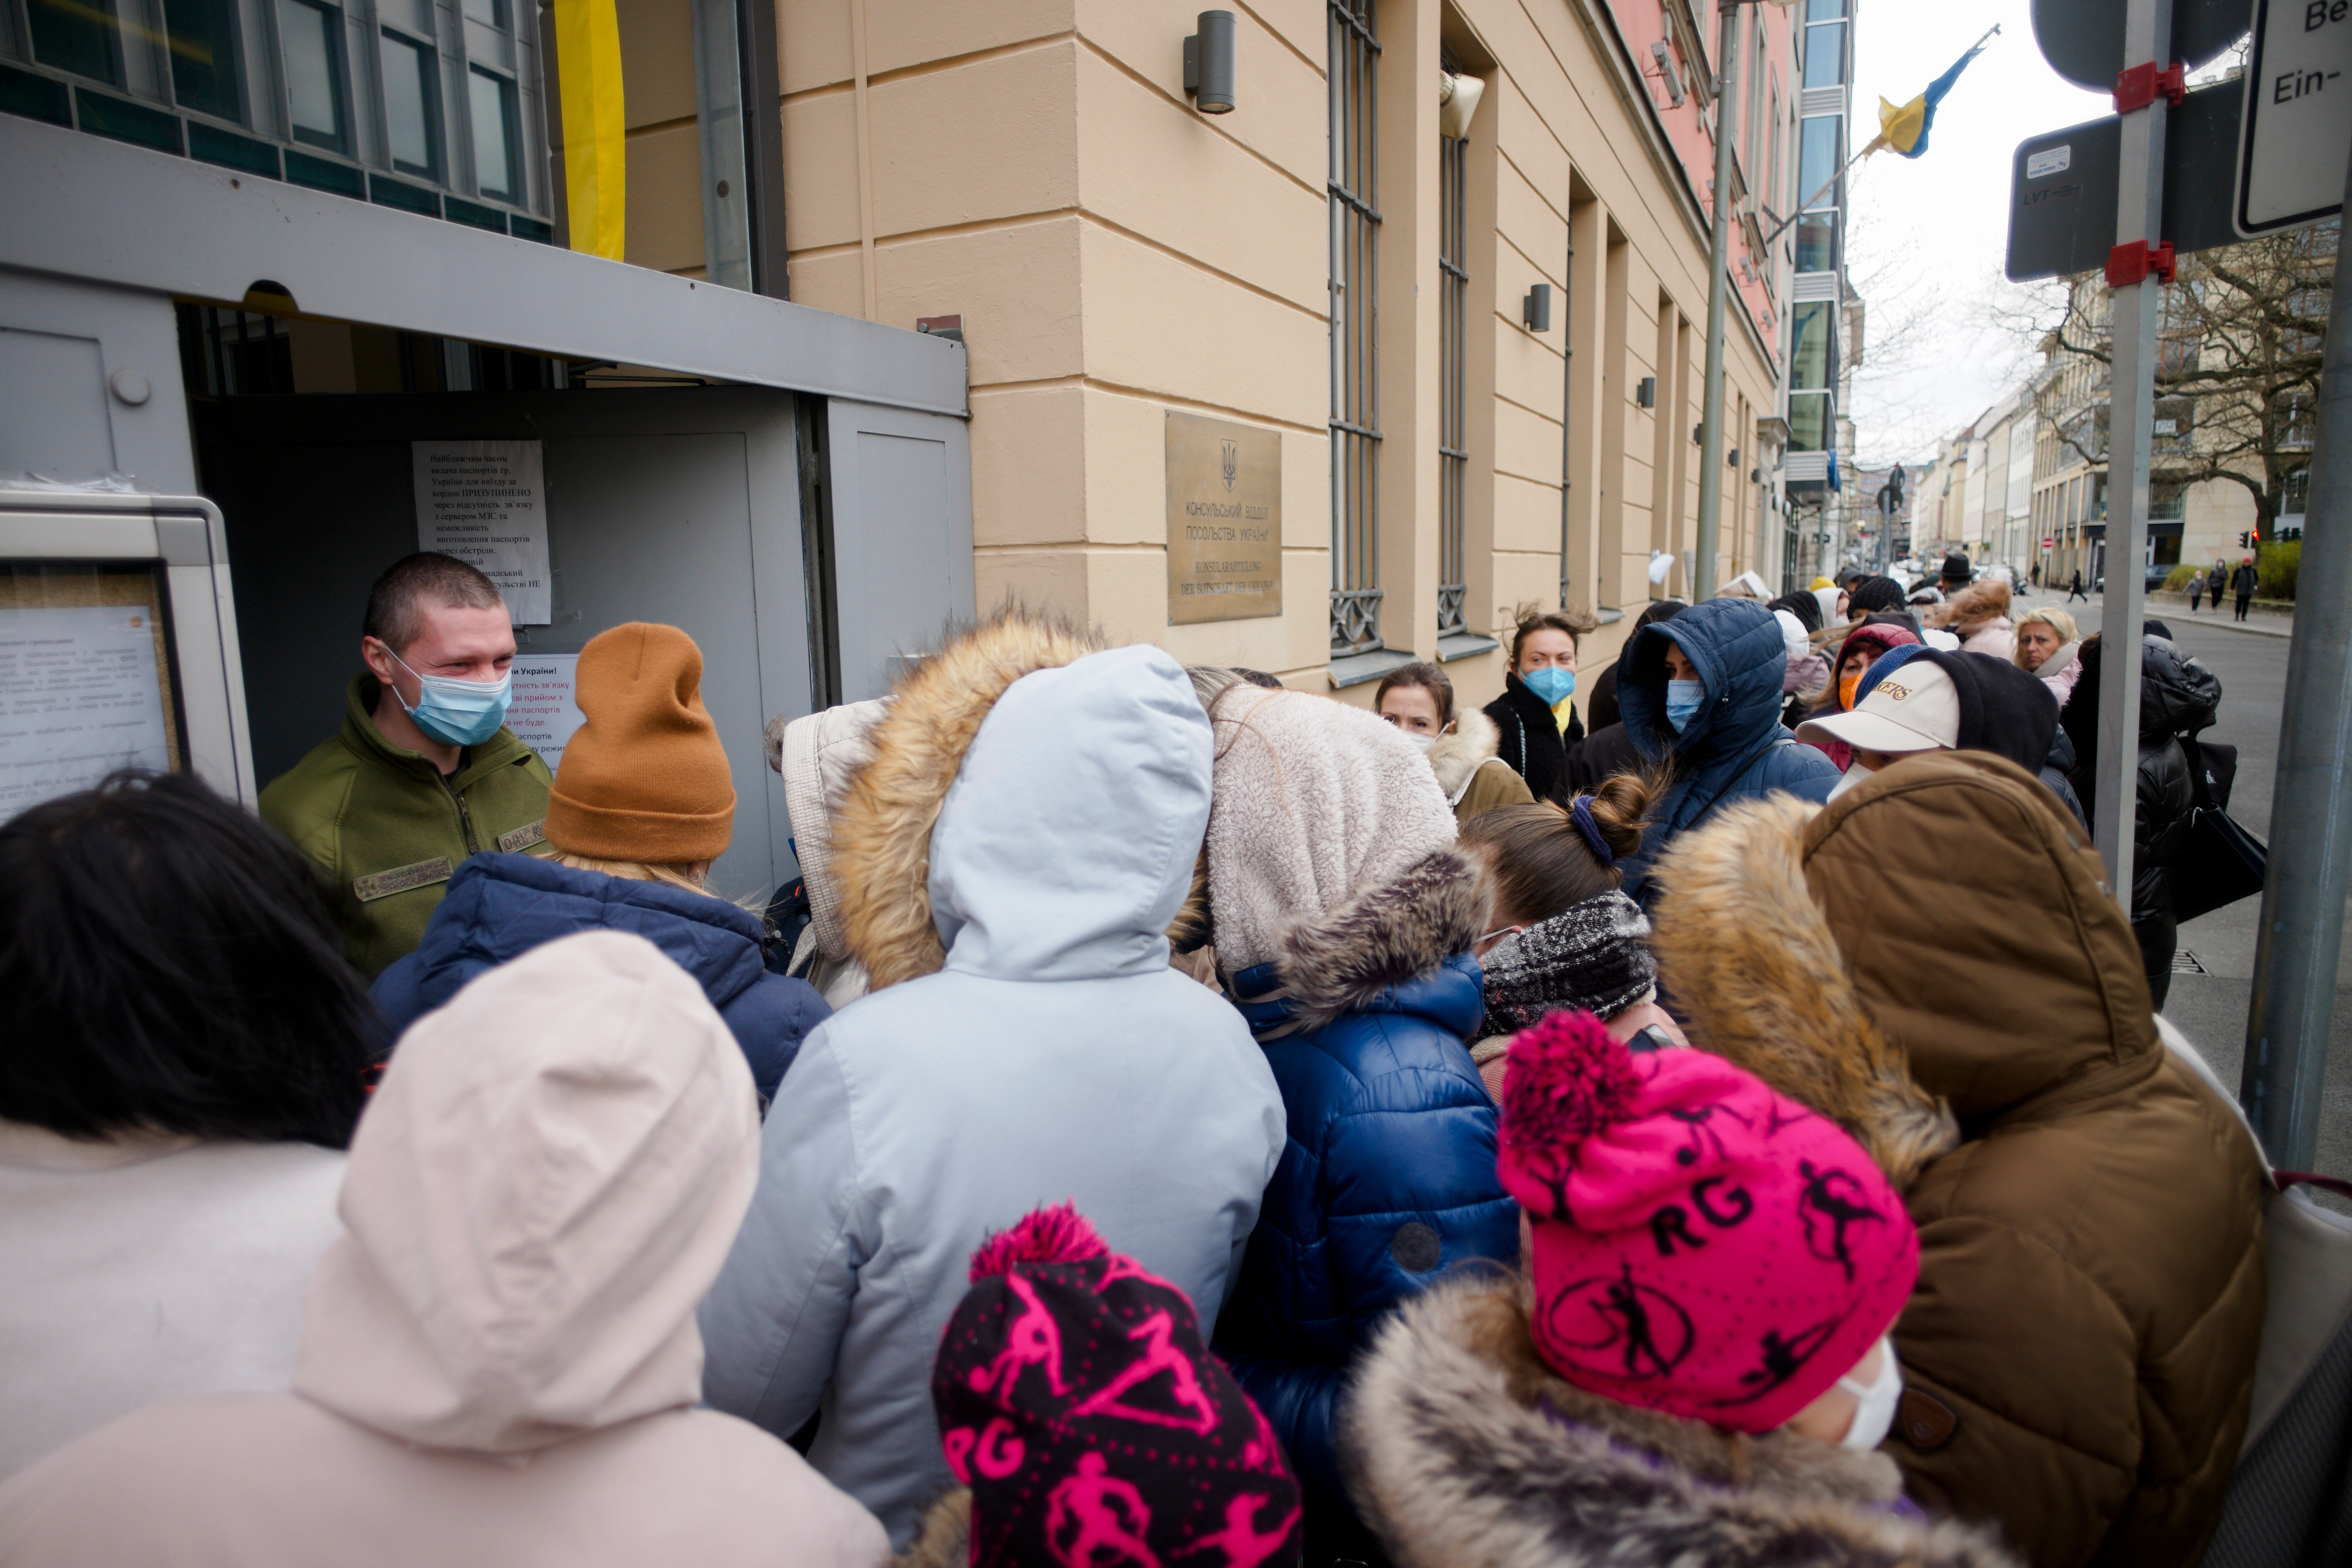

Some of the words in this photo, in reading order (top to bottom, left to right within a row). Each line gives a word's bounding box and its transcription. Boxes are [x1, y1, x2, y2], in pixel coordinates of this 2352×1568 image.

[2305, 0, 2352, 33] Be
[2274, 69, 2340, 105] Ein-
[2023, 188, 2050, 205] LVT
[460, 466, 498, 475] паспортів
[462, 489, 531, 497] ПРИЗУПИНЕНО
[457, 501, 500, 509] відсутність
[1186, 501, 1242, 518] КОНСУЛЬСЬКИЙ
[1187, 526, 1236, 541] ПОСОЛЬСТВА
[1240, 526, 1268, 541] УКРАЇНИ
[491, 535, 530, 544] паспортів
[460, 547, 496, 556] обстріли.
[1196, 561, 1261, 573] KONSULARABTEILUNG
[494, 580, 526, 589] сульстві
[1181, 584, 1194, 595] DER
[1197, 582, 1233, 594] BOTSCHAFT
[1235, 582, 1246, 592] DER
[1249, 581, 1273, 592] UKRAINE
[521, 667, 557, 676] України!
[511, 682, 539, 690] утність
[1871, 680, 1913, 702] KERS
[525, 694, 556, 703] прийом
[526, 719, 547, 727] буде.
[385, 877, 416, 891] BORDER
[418, 871, 445, 882] GUARD
[1649, 1175, 1755, 1256] RG
